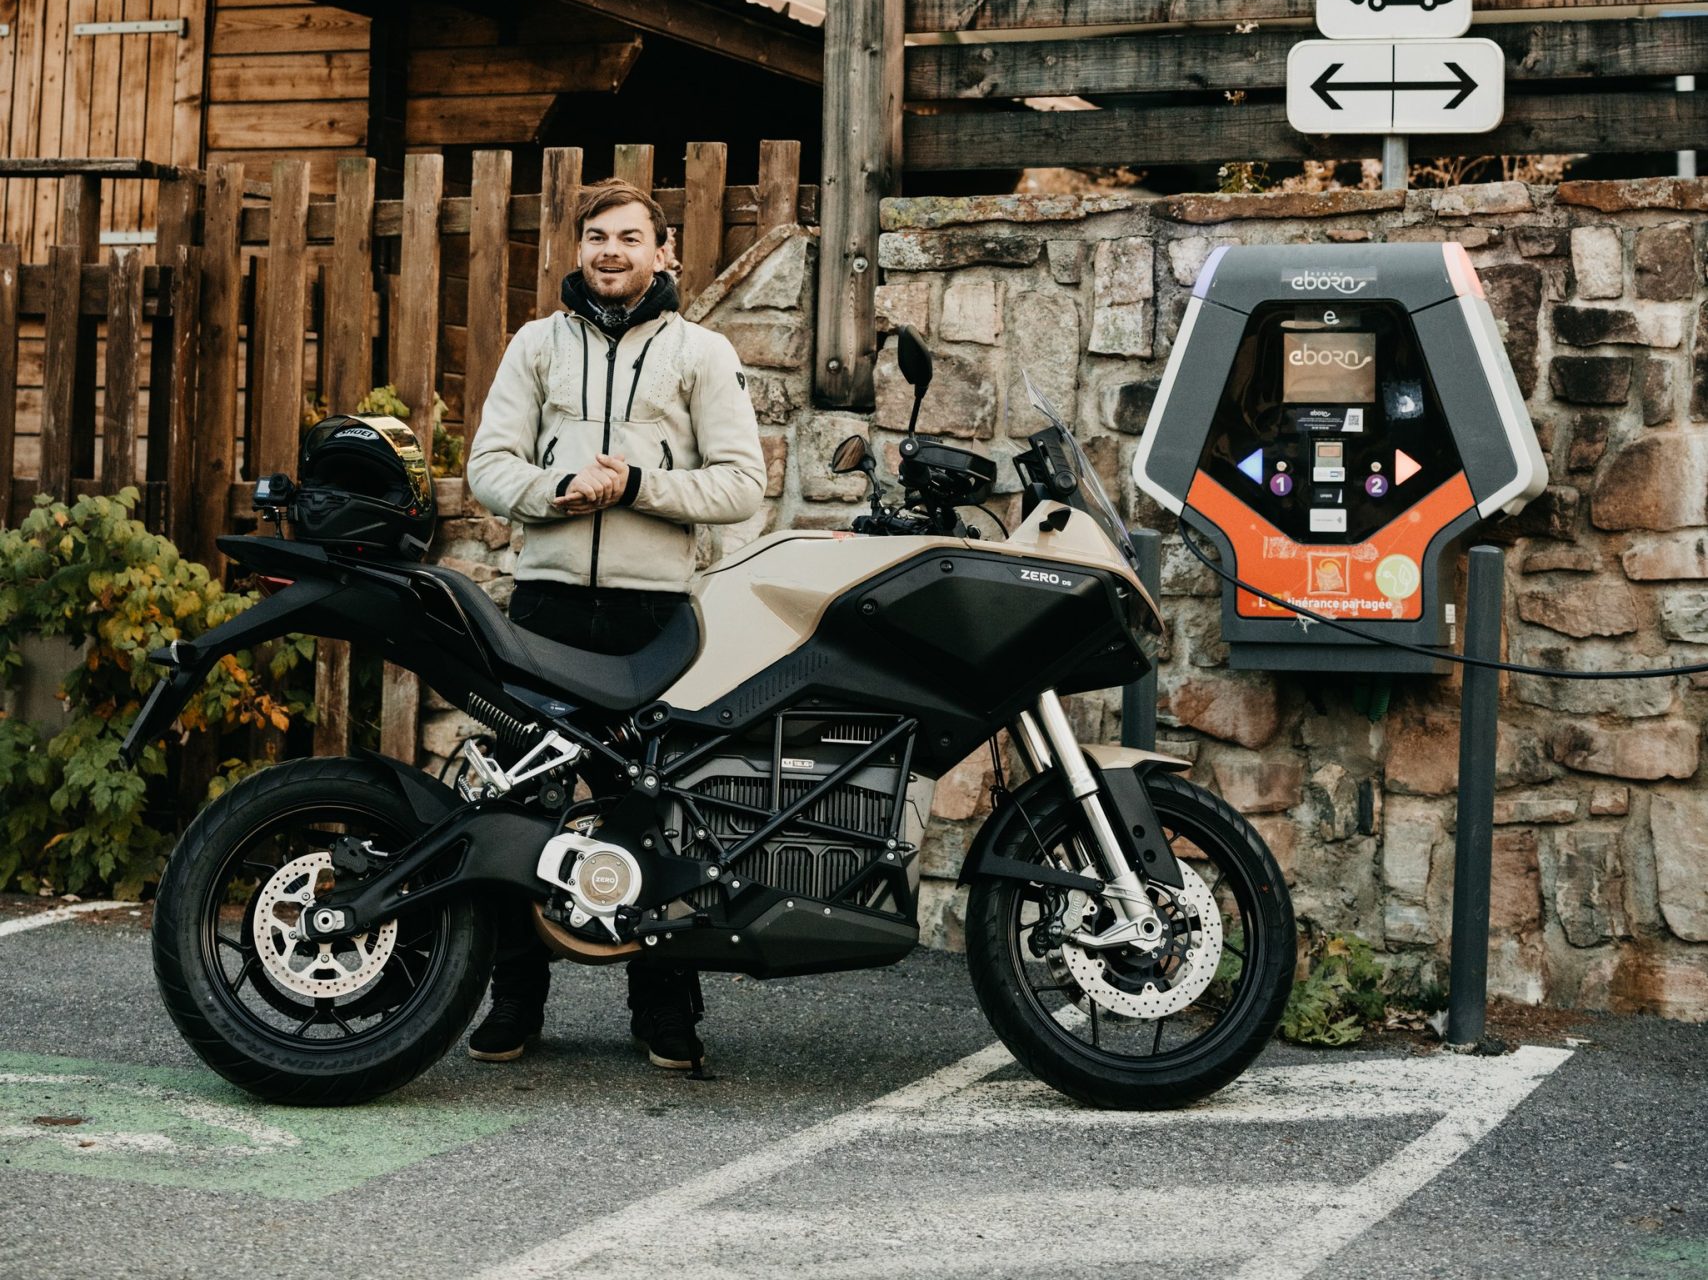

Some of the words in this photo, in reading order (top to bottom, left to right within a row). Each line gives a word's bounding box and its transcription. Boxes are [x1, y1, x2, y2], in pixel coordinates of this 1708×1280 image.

[1276, 476, 1285, 492] 1
[1371, 477, 1383, 493] 2
[1020, 569, 1059, 585] ZERO
[1342, 597, 1393, 612] partagée
[595, 876, 615, 884] ZERO
